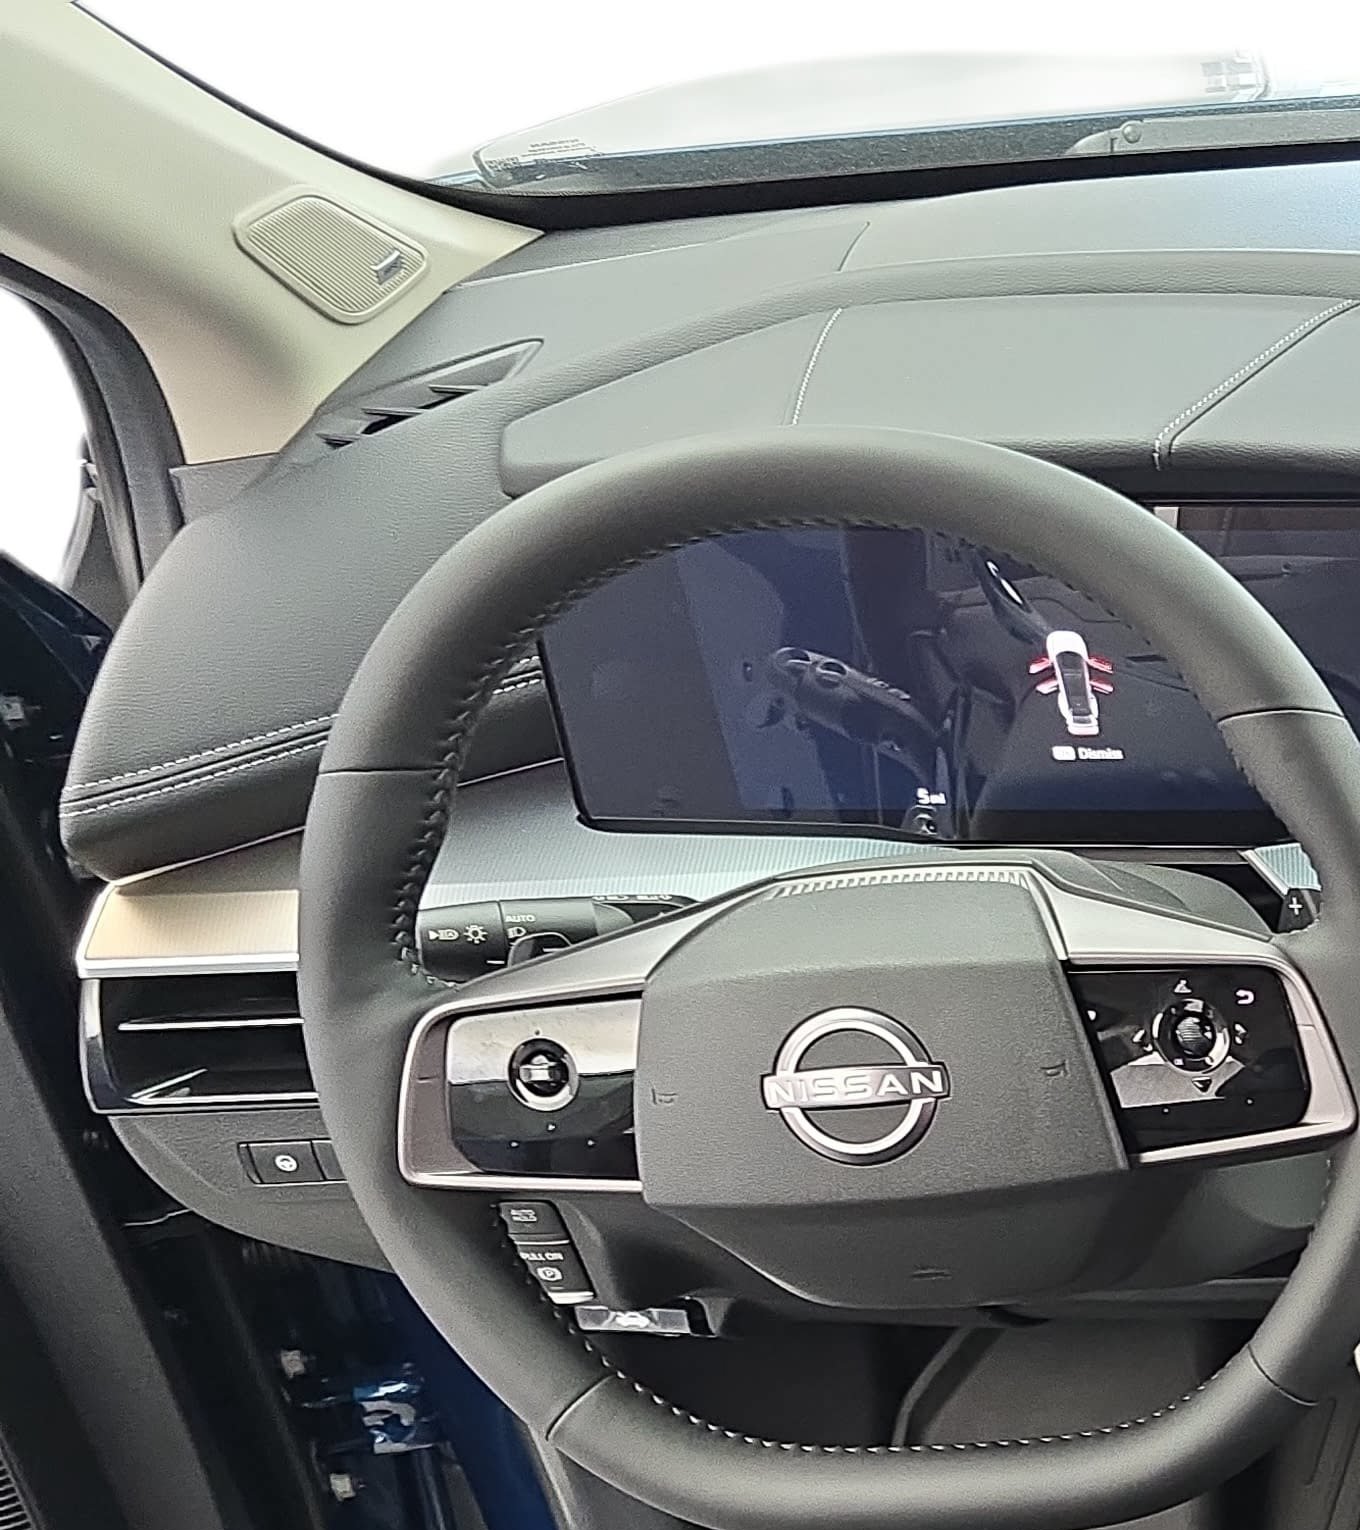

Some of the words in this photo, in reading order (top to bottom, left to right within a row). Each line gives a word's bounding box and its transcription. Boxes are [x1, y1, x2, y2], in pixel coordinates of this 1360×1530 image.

[505, 914, 536, 923] AUTO
[769, 1070, 945, 1104] NISSAN
[544, 1251, 564, 1261] ON
